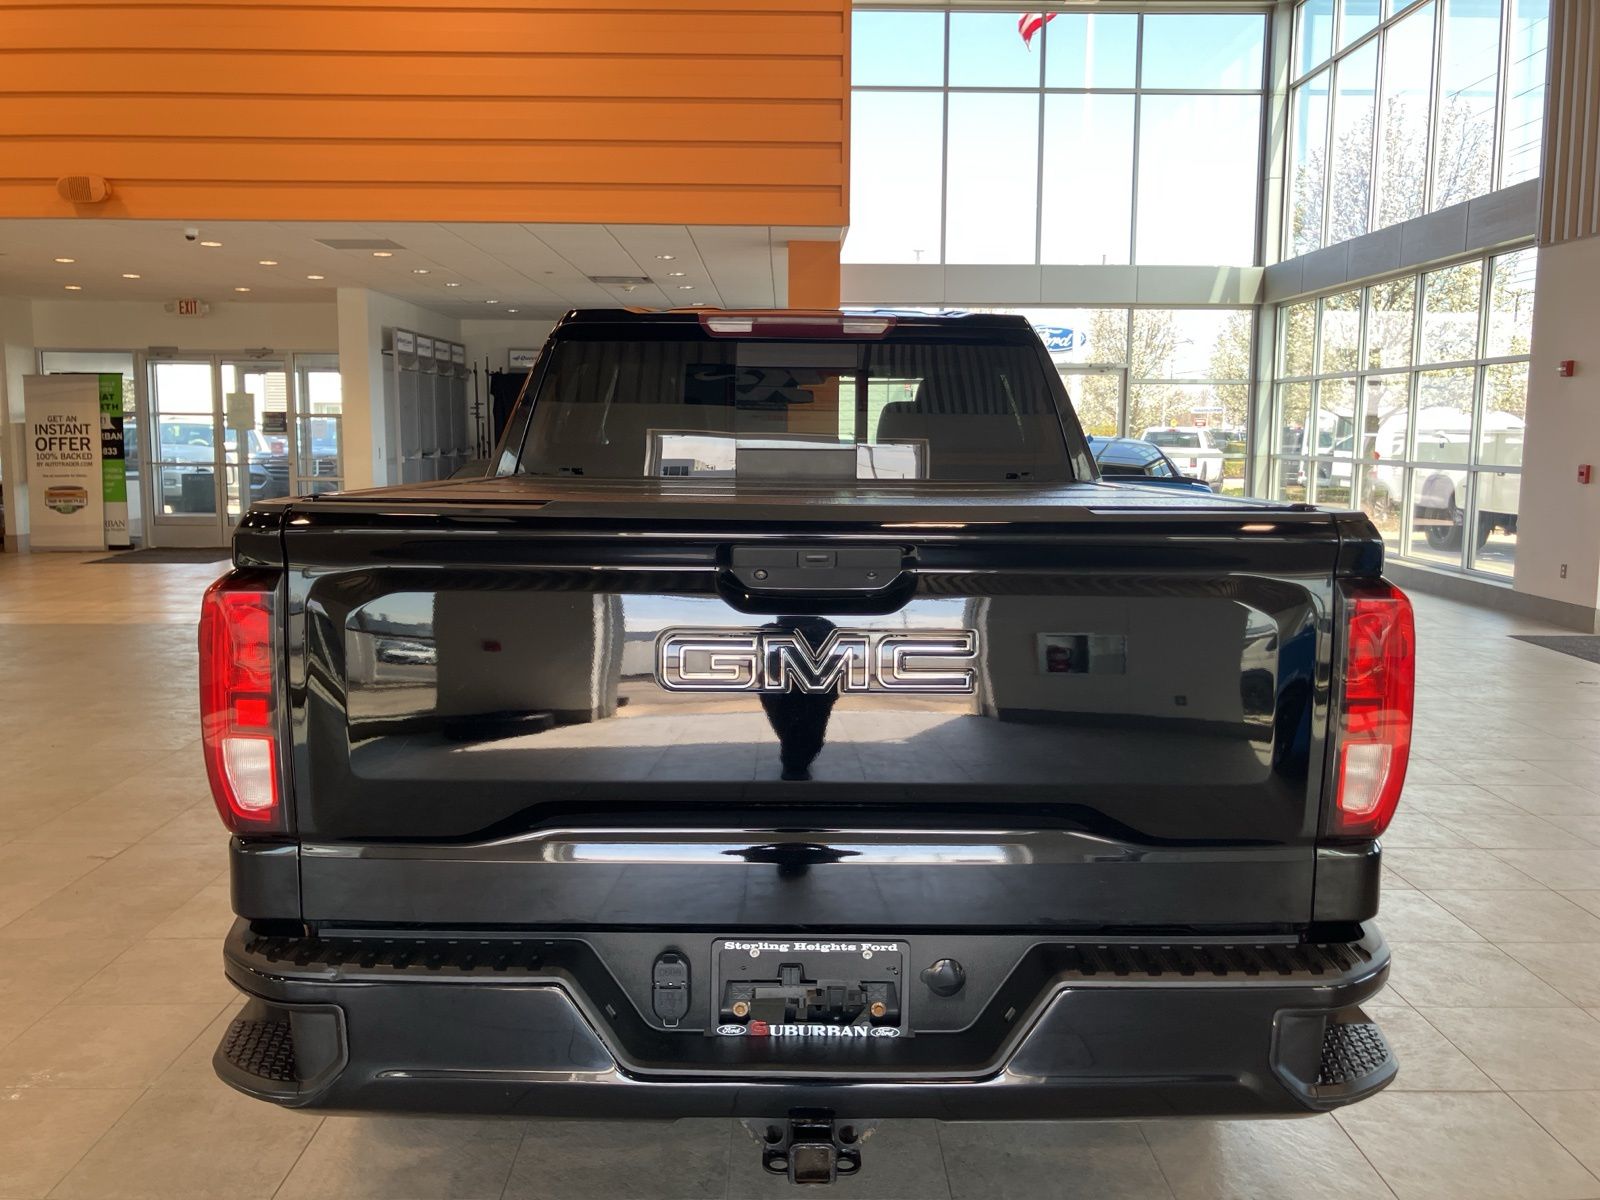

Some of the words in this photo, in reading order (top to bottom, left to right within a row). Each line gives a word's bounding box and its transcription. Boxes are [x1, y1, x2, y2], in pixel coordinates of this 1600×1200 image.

[178, 299, 197, 315] EXIT
[47, 415, 62, 423] GET
[65, 415, 77, 423] AN
[34, 423, 91, 435] INSTANT
[35, 437, 91, 451] OFFER
[36, 452, 58, 460] 100%
[60, 452, 93, 460] BACKED
[654, 626, 978, 694] GMC
[724, 941, 790, 952] Sterling
[793, 942, 857, 953] Heights
[860, 942, 898, 952] Ford
[719, 1024, 744, 1035] Ford
[750, 1021, 868, 1037] SUBURBAN
[873, 1027, 898, 1037] Ford
